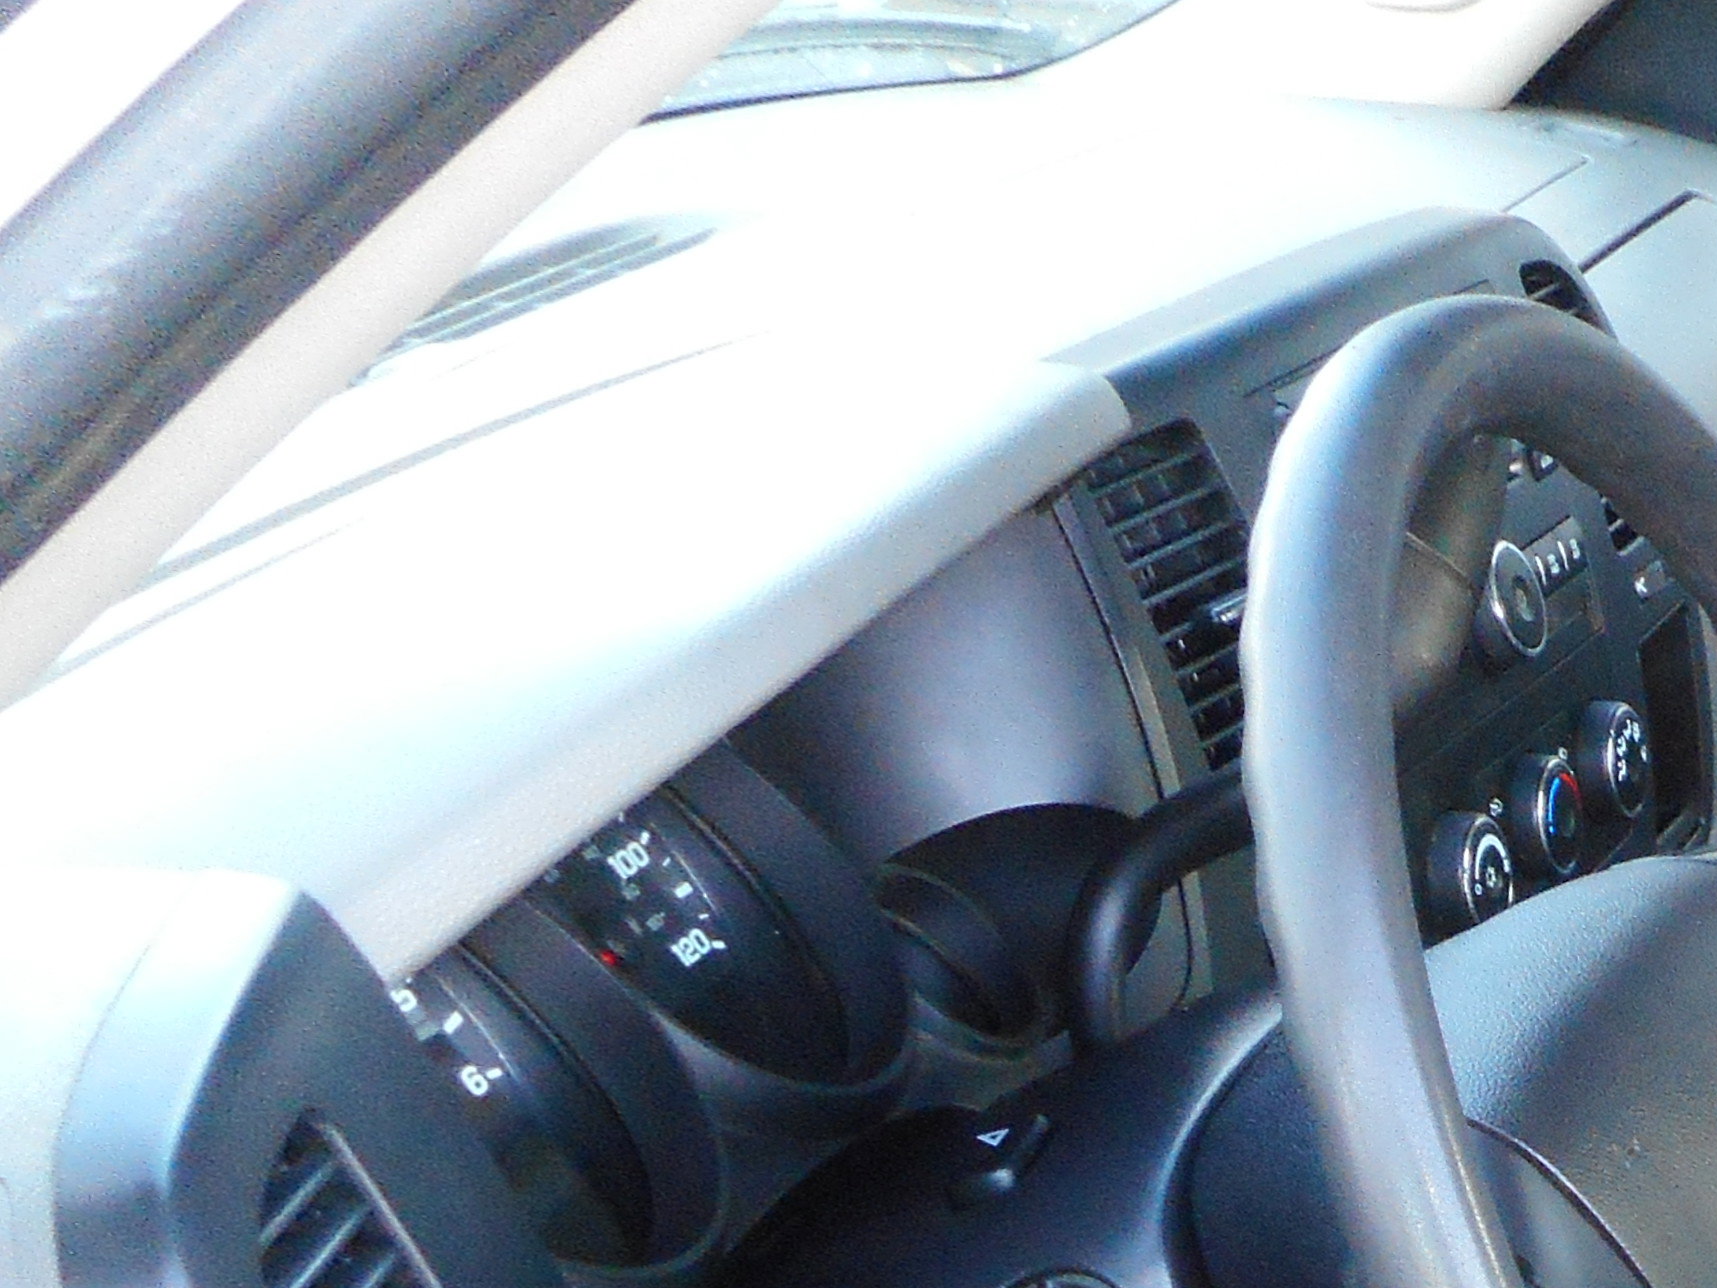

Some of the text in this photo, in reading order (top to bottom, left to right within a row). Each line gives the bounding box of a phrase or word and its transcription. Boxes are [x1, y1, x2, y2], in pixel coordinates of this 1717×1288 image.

[607, 841, 650, 879] 100
[670, 928, 712, 967] 120
[460, 1065, 489, 1096] 6
